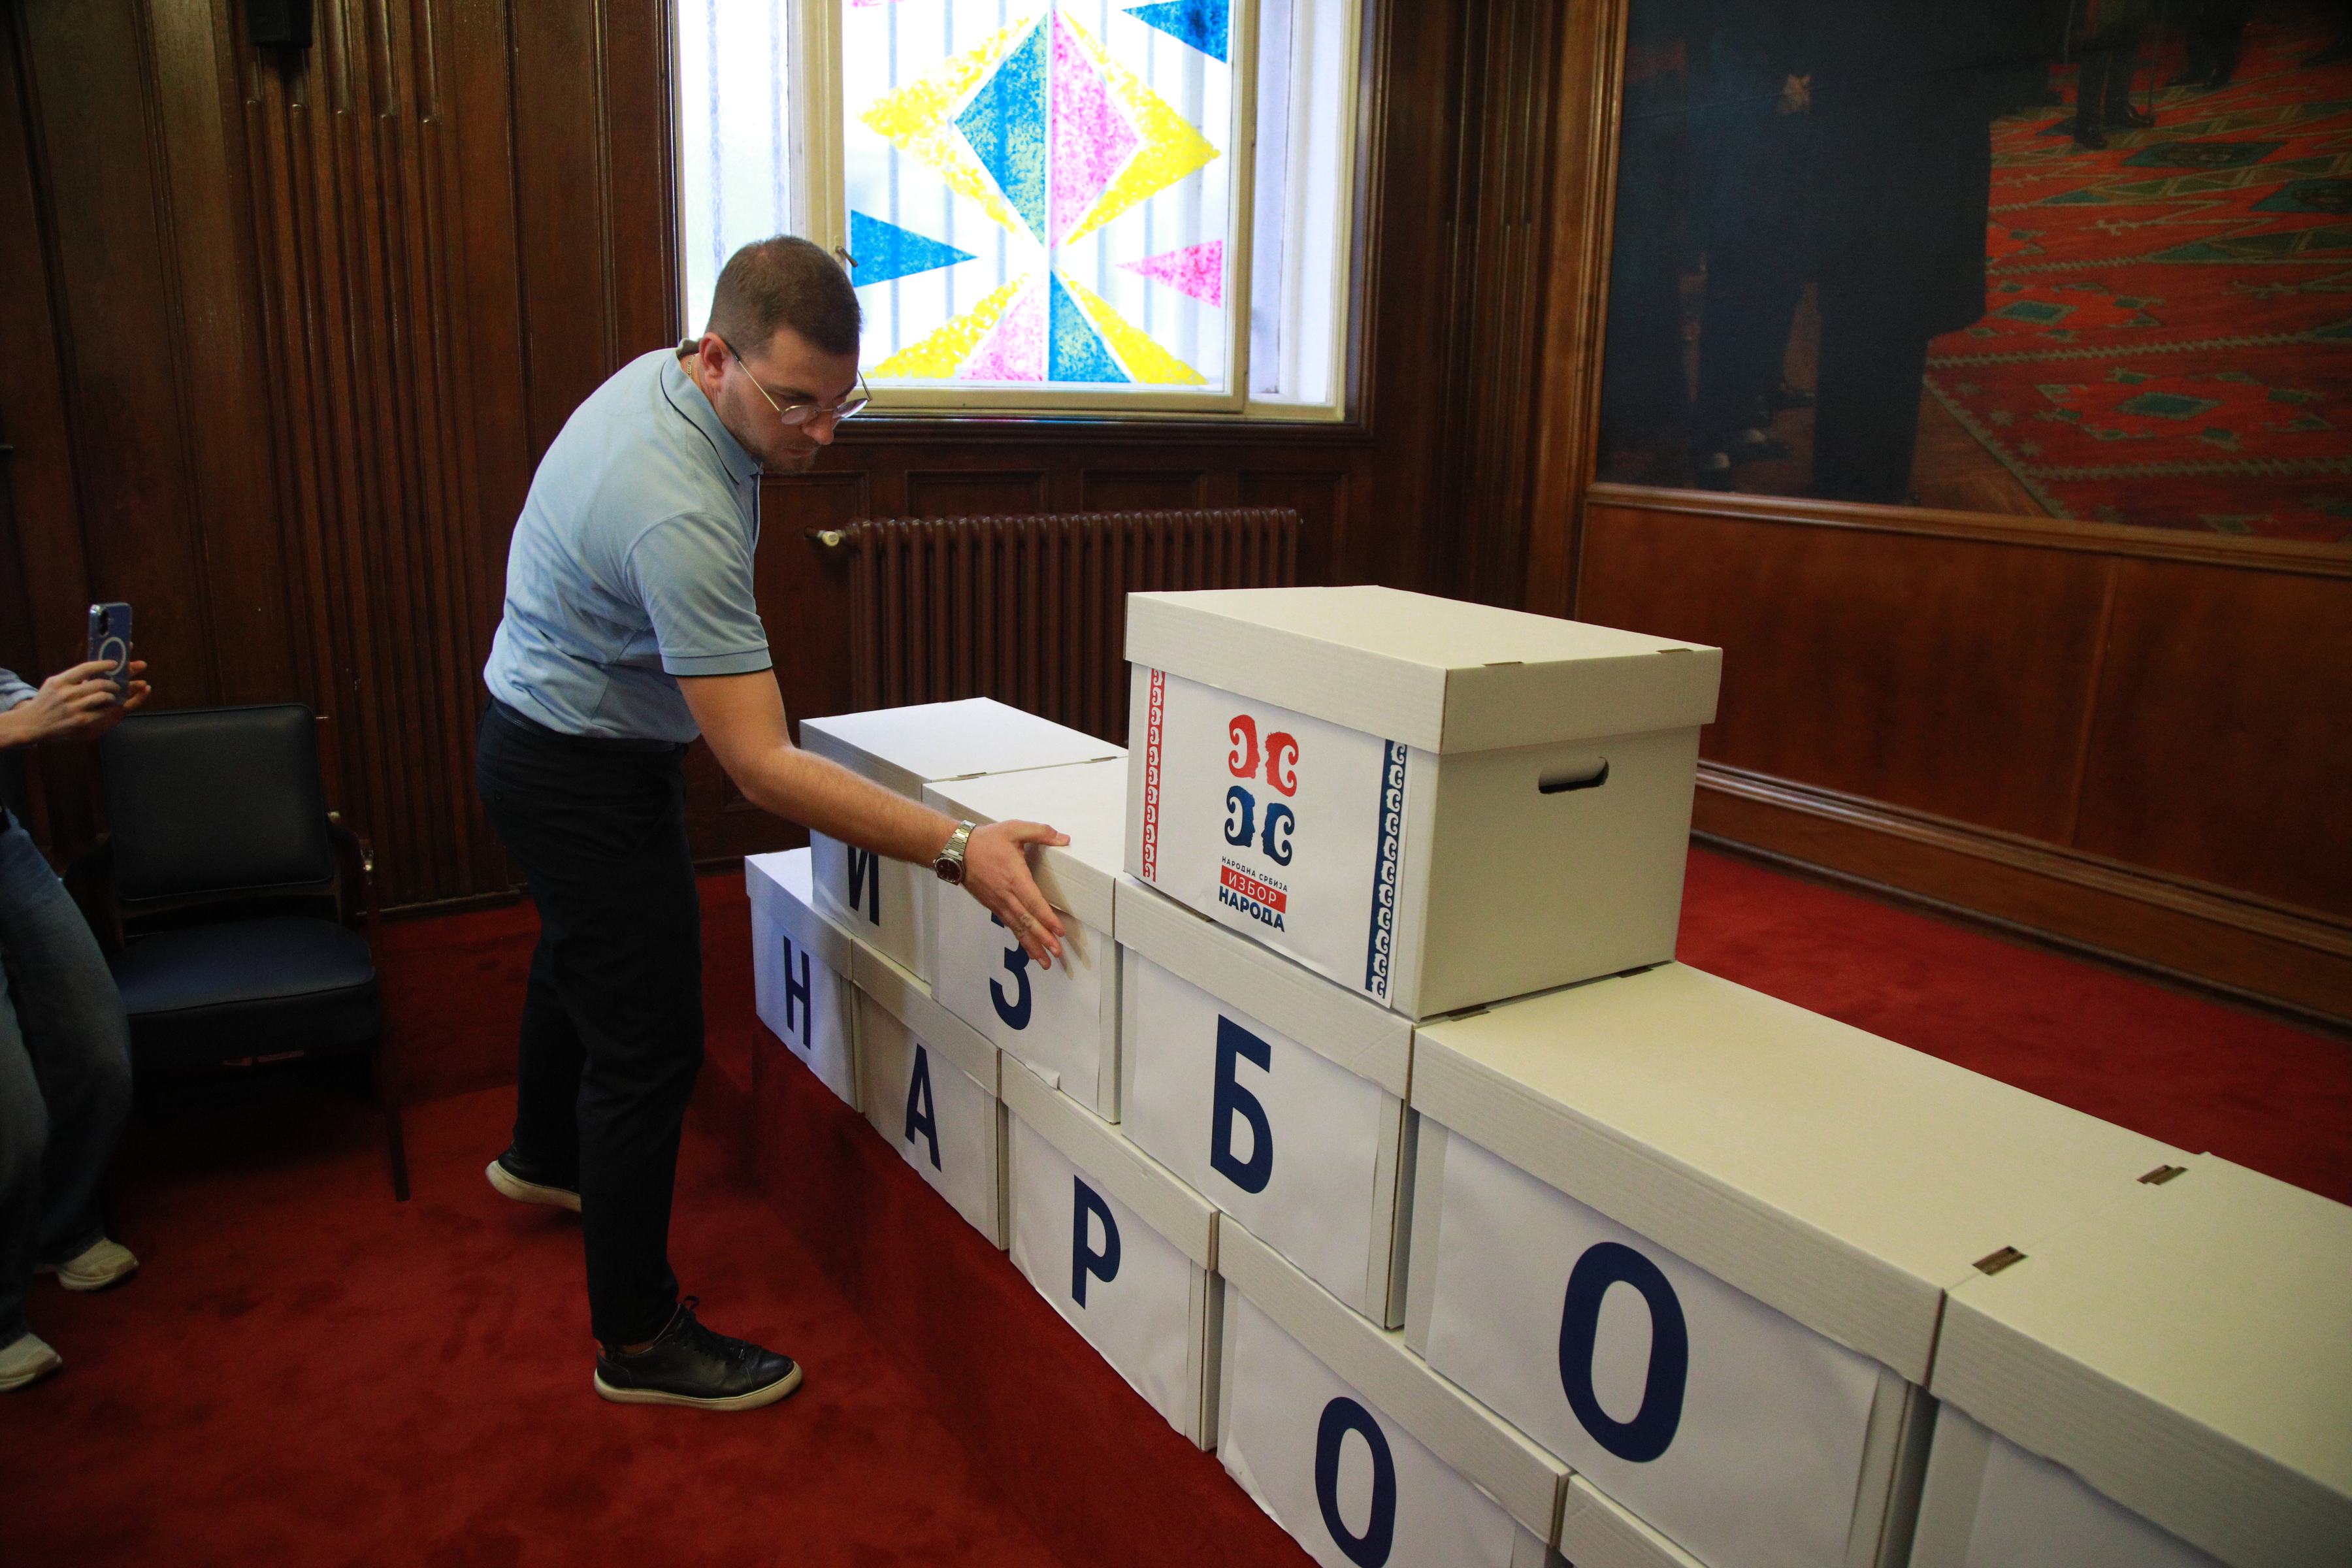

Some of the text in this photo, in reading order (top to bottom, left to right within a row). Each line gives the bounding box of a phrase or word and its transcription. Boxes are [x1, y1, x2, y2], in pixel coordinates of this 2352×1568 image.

[1222, 856, 1288, 892] НАРОДНА СРБИЈА
[1228, 872, 1277, 904] ИЗБОР
[1218, 885, 1285, 933] НАРОДА
[783, 935, 811, 1051] Н
[905, 1043, 942, 1173] А
[1071, 1174, 1121, 1310] Р
[1210, 1014, 1273, 1194] Б
